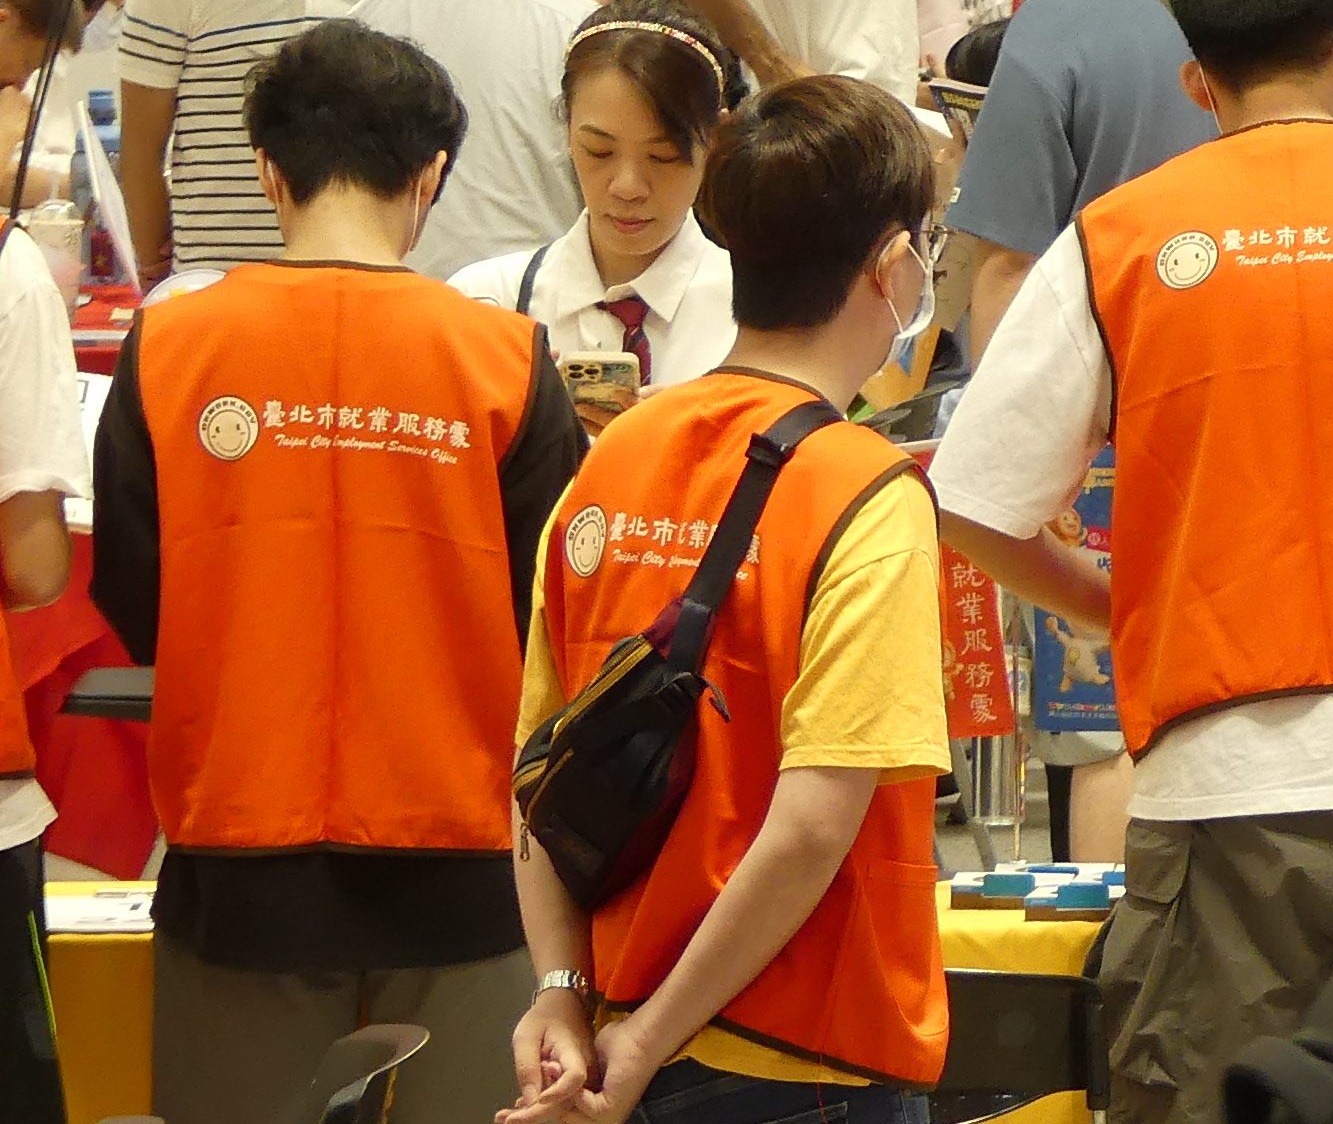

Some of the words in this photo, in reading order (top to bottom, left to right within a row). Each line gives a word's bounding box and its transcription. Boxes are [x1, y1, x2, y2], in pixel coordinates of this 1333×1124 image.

[1236, 253, 1268, 266] Taipei
[1271, 252, 1293, 265] City
[263, 399, 471, 449] 臺北市就業服務處
[275, 433, 307, 449] Taipei
[310, 434, 331, 449] City
[387, 440, 430, 457] Services
[430, 447, 459, 465] Office
[612, 549, 640, 564] Taipei
[641, 550, 667, 568] City
[952, 548, 997, 724] 就業服務處
